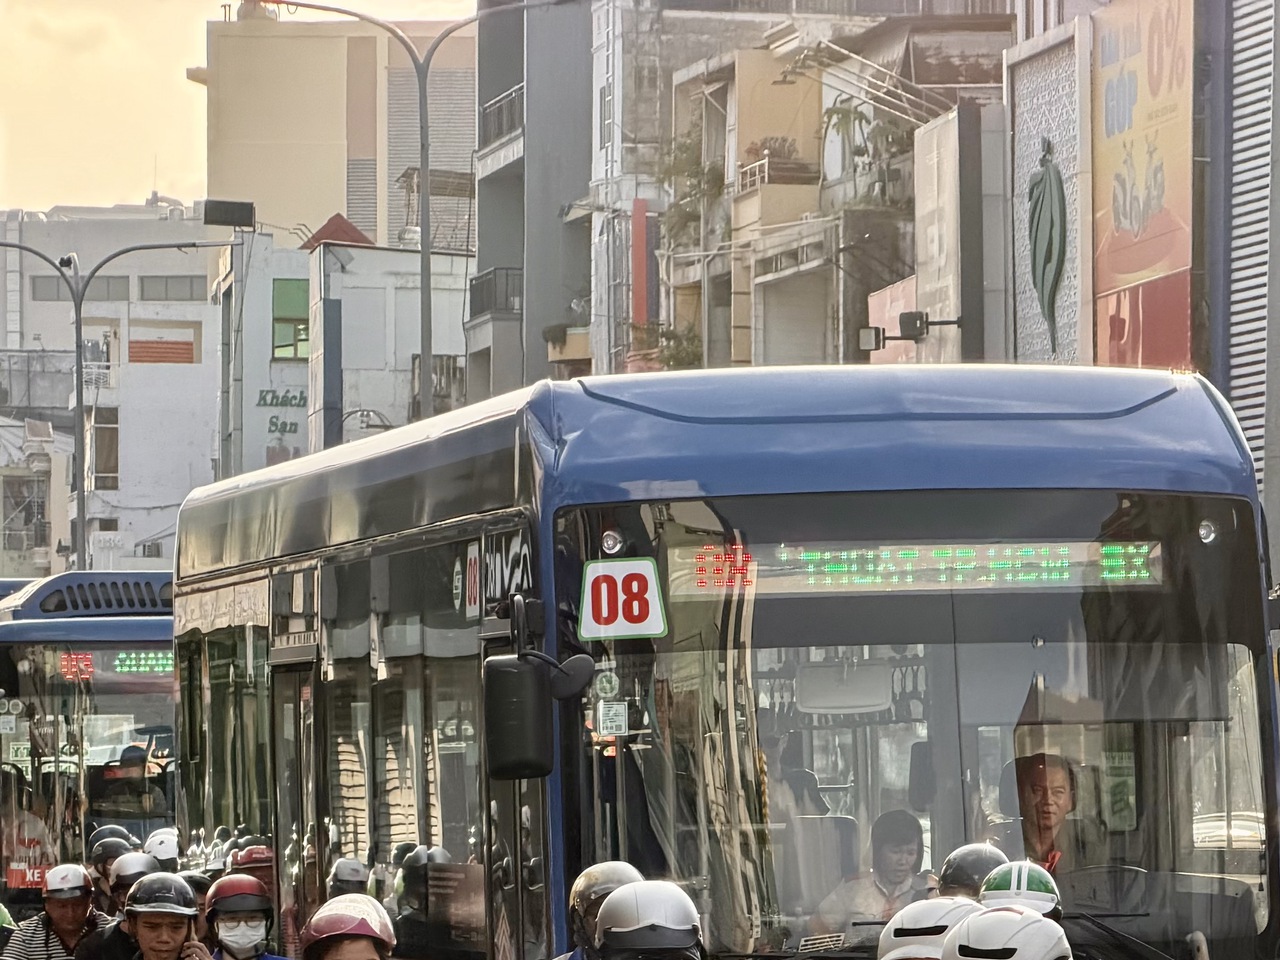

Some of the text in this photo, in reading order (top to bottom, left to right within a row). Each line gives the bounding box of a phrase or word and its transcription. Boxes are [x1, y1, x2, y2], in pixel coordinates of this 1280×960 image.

[256, 389, 307, 407] Khách
[467, 556, 478, 607] 08
[590, 572, 650, 626] 08
[25, 869, 42, 882] XE
